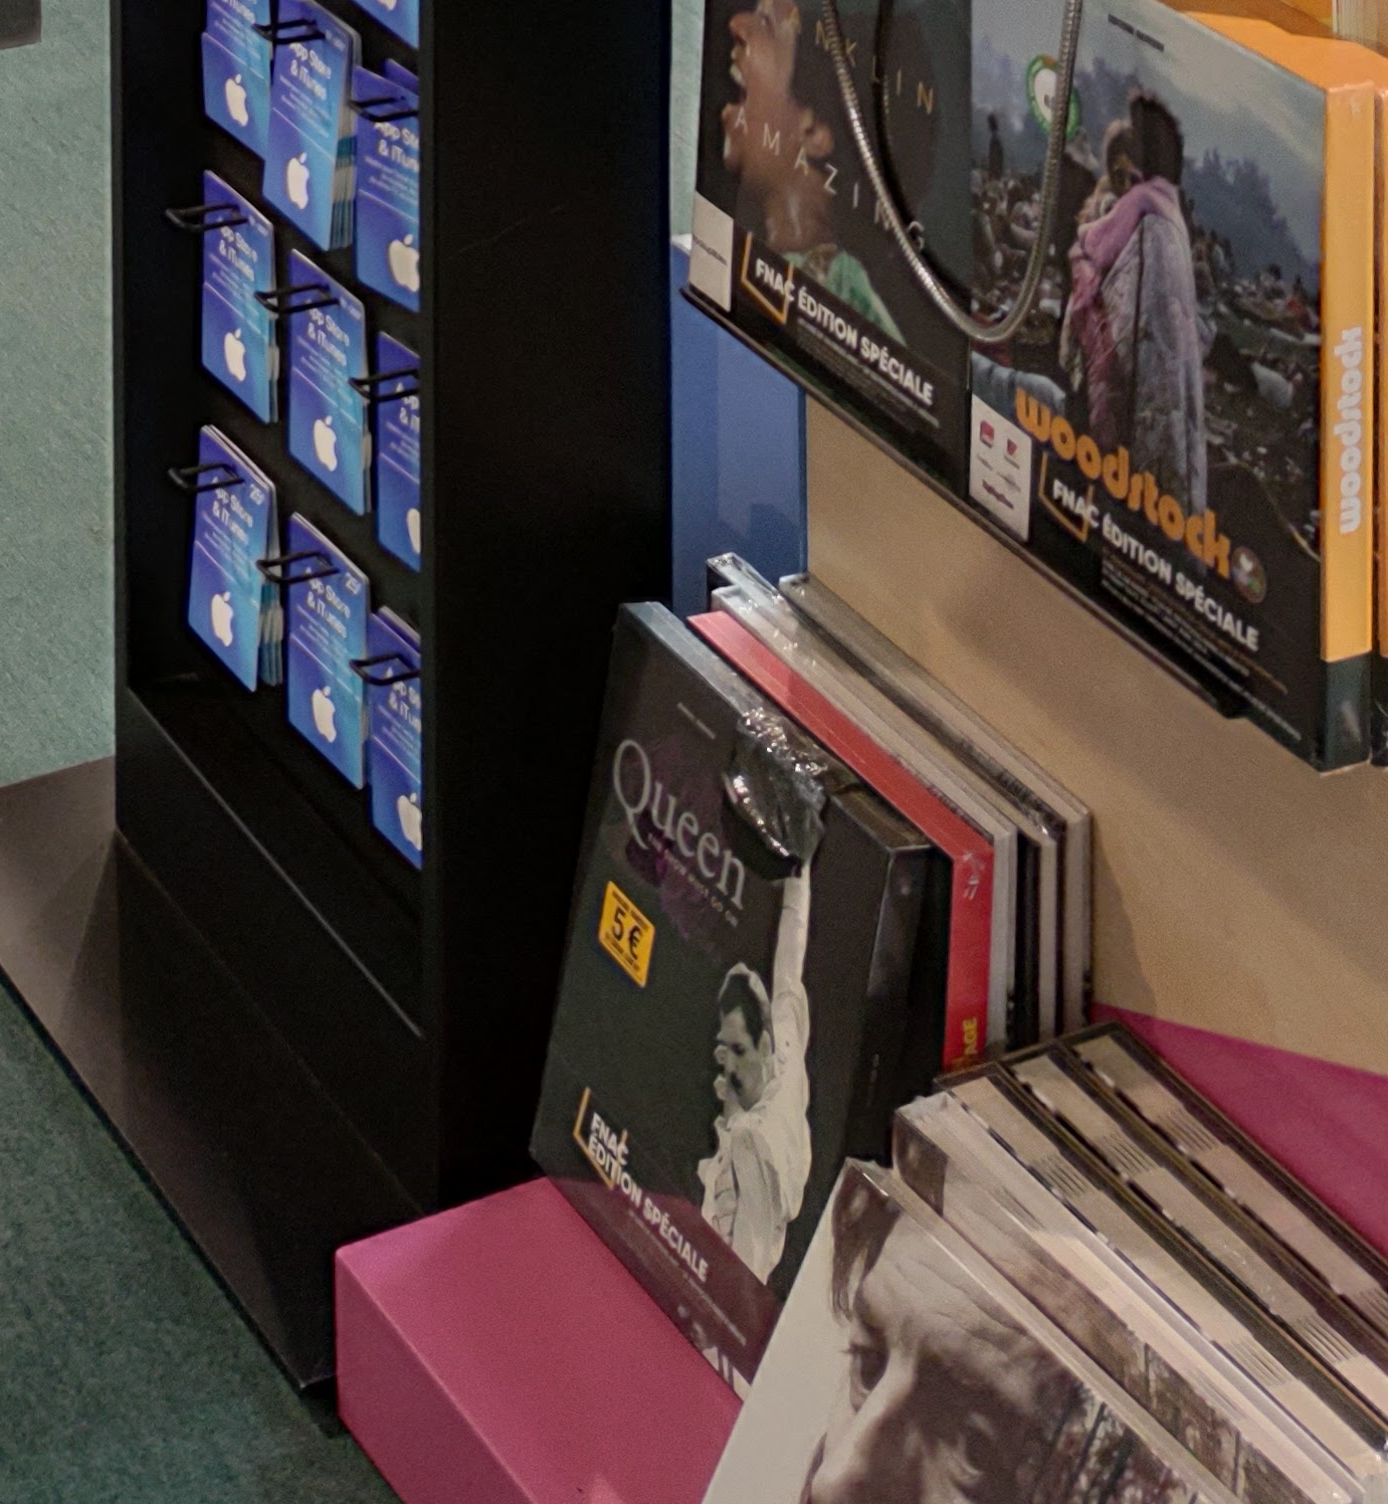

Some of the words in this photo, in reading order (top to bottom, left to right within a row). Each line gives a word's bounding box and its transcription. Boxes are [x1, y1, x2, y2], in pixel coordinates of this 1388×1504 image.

[755, 257, 796, 302] FNAC
[797, 286, 859, 350] ÉDITION
[860, 335, 935, 407] SPÉCIALE
[1015, 386, 1232, 580] woodstock
[1333, 326, 1363, 536] woodstock
[1052, 477, 1100, 528] FNAC
[1101, 510, 1173, 586] ÉDITION
[1175, 571, 1260, 653] SPÉCIALE
[614, 739, 746, 912] Queen
[612, 907, 625, 943] 5
[587, 1130, 643, 1208] ÉDITION
[643, 1196, 709, 1284] SPÉCIALE
[590, 1110, 630, 1166] FNAC
